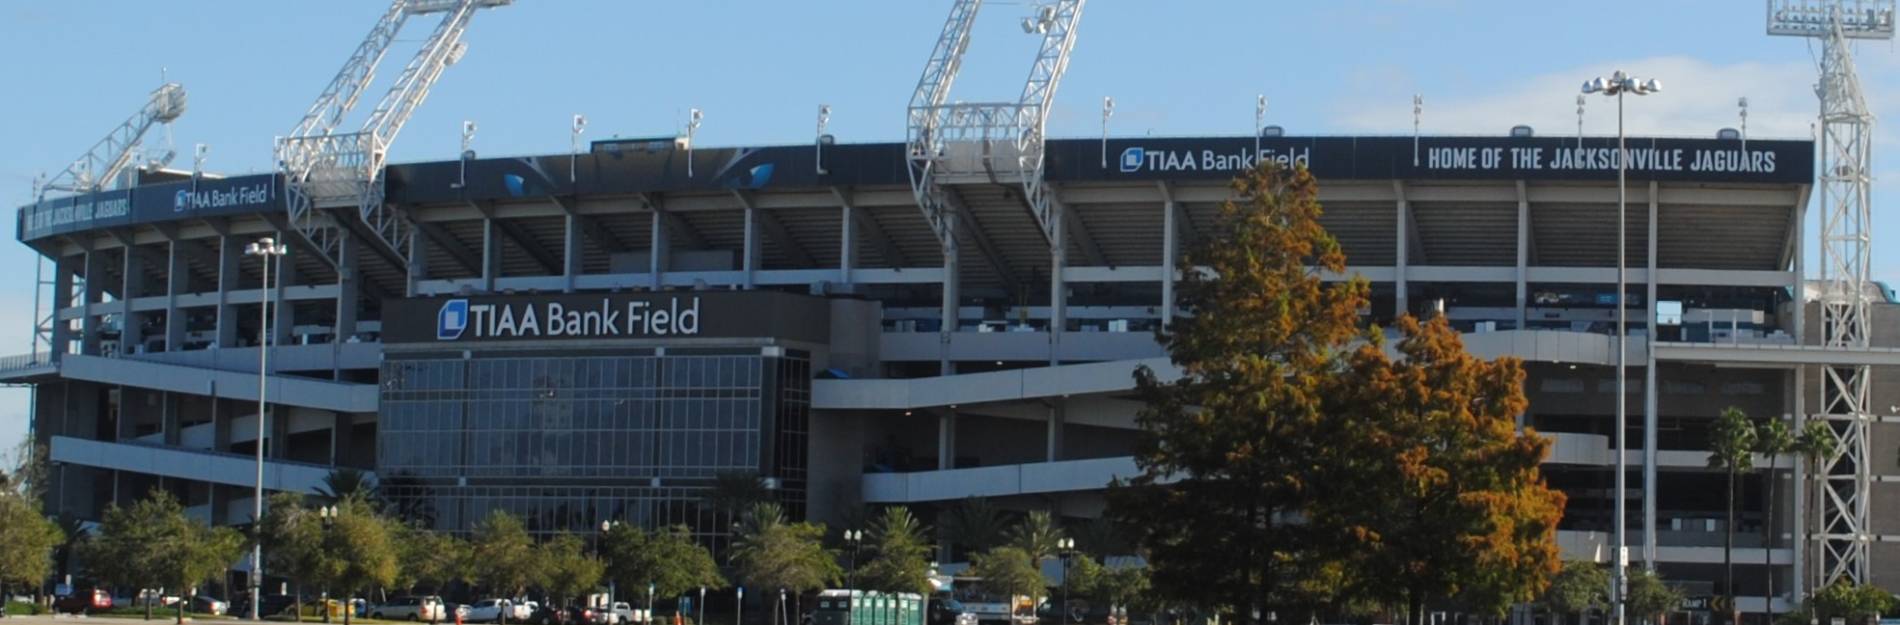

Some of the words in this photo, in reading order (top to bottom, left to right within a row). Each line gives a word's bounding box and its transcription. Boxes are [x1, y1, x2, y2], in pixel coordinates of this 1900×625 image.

[1145, 150, 1197, 171] TIAA
[1202, 147, 1254, 171] Bank
[1259, 147, 1309, 171] Field
[1428, 147, 1477, 169] HOME
[1481, 147, 1504, 169] OF
[1510, 147, 1543, 169] THE
[1550, 147, 1683, 171] JACKSONVILLE
[1689, 149, 1776, 173] JAGUARS
[185, 190, 211, 209] TIAA
[212, 186, 238, 207] Bank
[240, 184, 268, 205] Field
[53, 202, 93, 226] JACKSOVILLE
[469, 303, 541, 337] TIAA
[546, 298, 619, 337] Bank
[627, 297, 700, 335] Field
